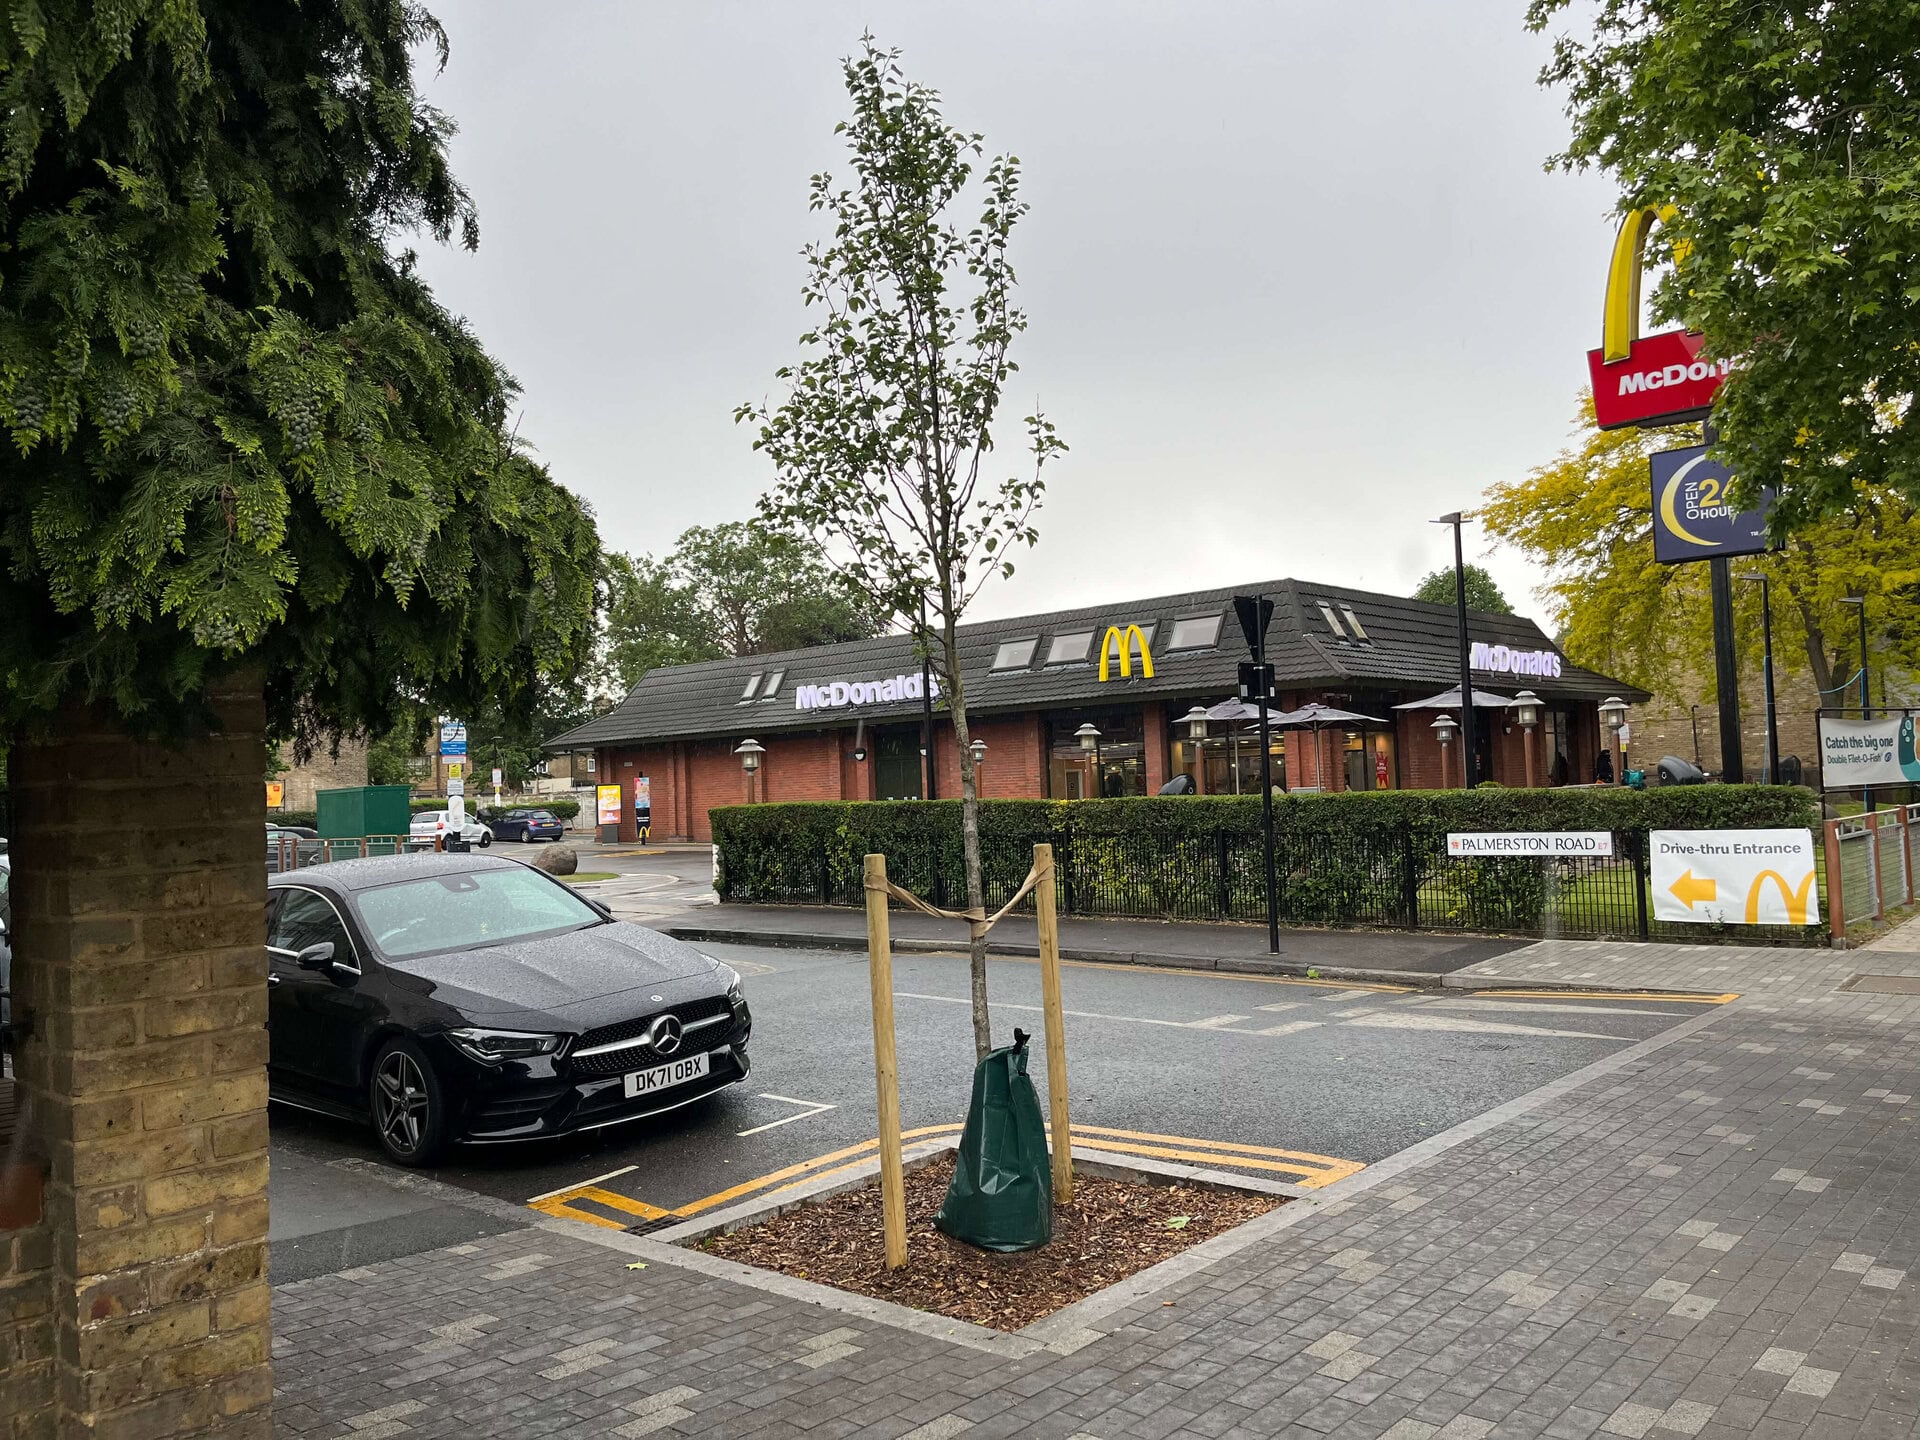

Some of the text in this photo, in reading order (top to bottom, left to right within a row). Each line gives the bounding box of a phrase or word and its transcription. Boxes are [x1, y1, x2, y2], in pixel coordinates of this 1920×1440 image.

[1685, 481, 1699, 520] OPEN
[1469, 642, 1561, 678] McDonald's
[1826, 734, 1893, 751] Catch the big one
[1827, 754, 1847, 764] Double
[1462, 837, 1608, 851] PALMERSTON ROAD E7
[1660, 843, 1802, 855] Drive-thru Entrance
[635, 1057, 702, 1091] DK71 OBX
